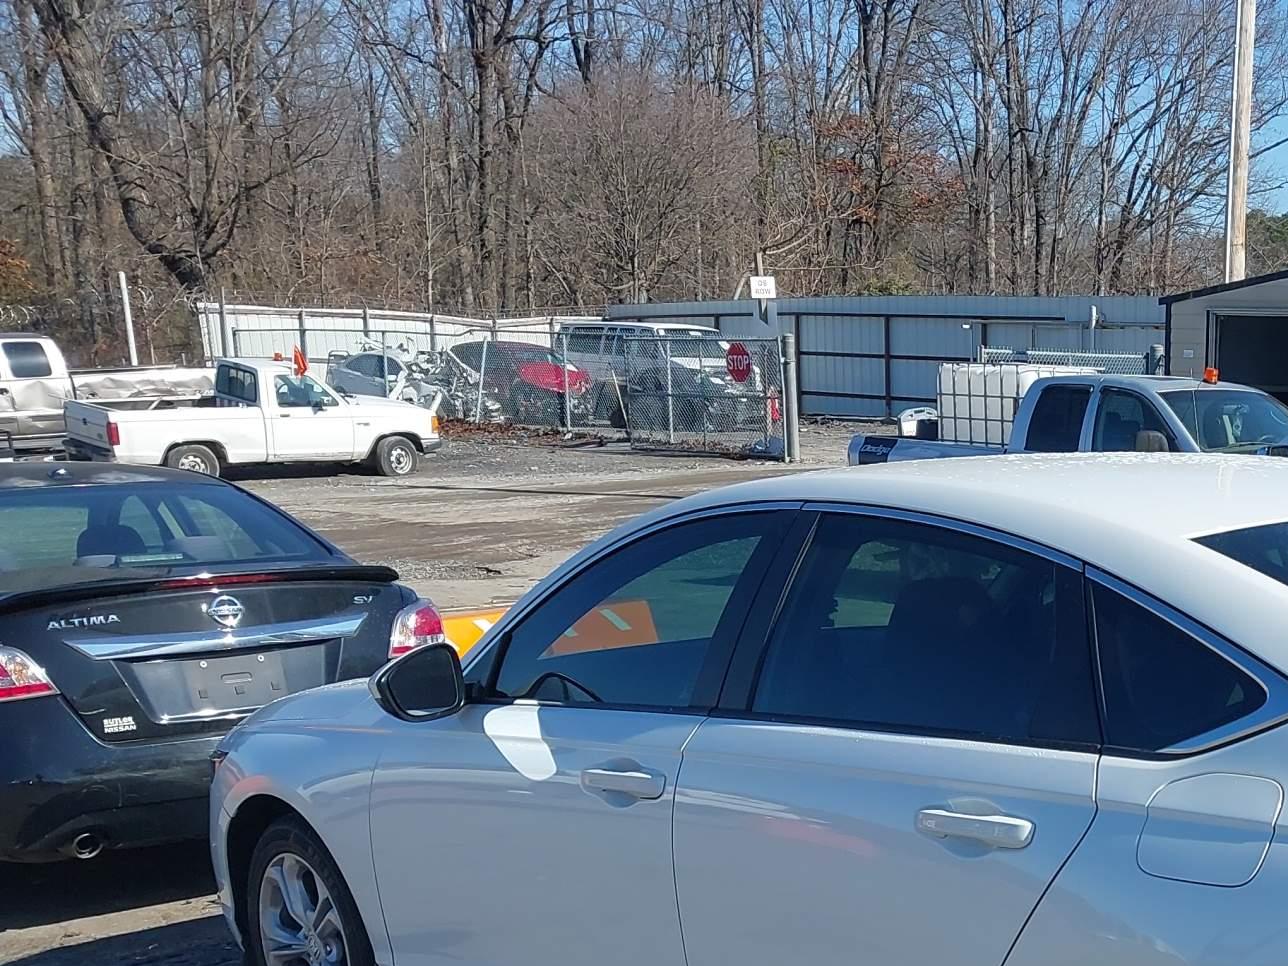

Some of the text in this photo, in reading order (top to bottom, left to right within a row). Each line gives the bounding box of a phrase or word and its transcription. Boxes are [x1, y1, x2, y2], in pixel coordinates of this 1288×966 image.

[728, 355, 749, 370] STOP
[353, 595, 373, 604] SV
[47, 614, 121, 630] ALTIMA
